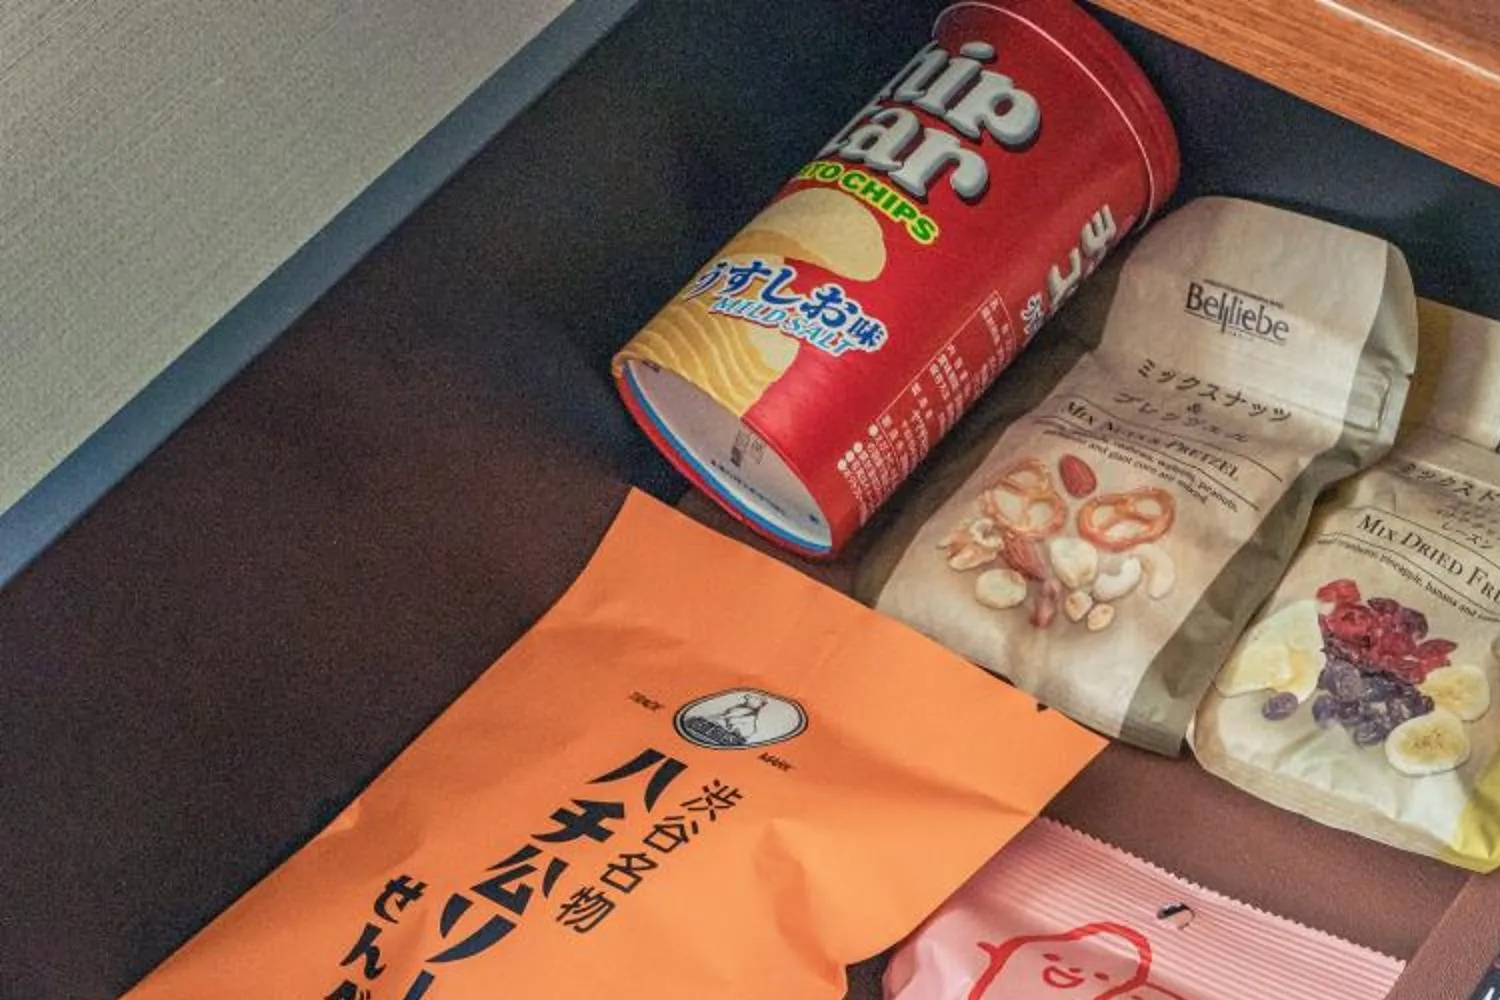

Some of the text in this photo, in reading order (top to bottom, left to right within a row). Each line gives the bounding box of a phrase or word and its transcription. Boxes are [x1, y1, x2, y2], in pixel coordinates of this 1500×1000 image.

[839, 170, 939, 244] CHIPS
[713, 297, 853, 354] MILD SALT
[1185, 281, 1290, 341] Belliebe
[1138, 358, 1292, 422] ミックスナッツ
[555, 779, 744, 934] 渋谷名物
